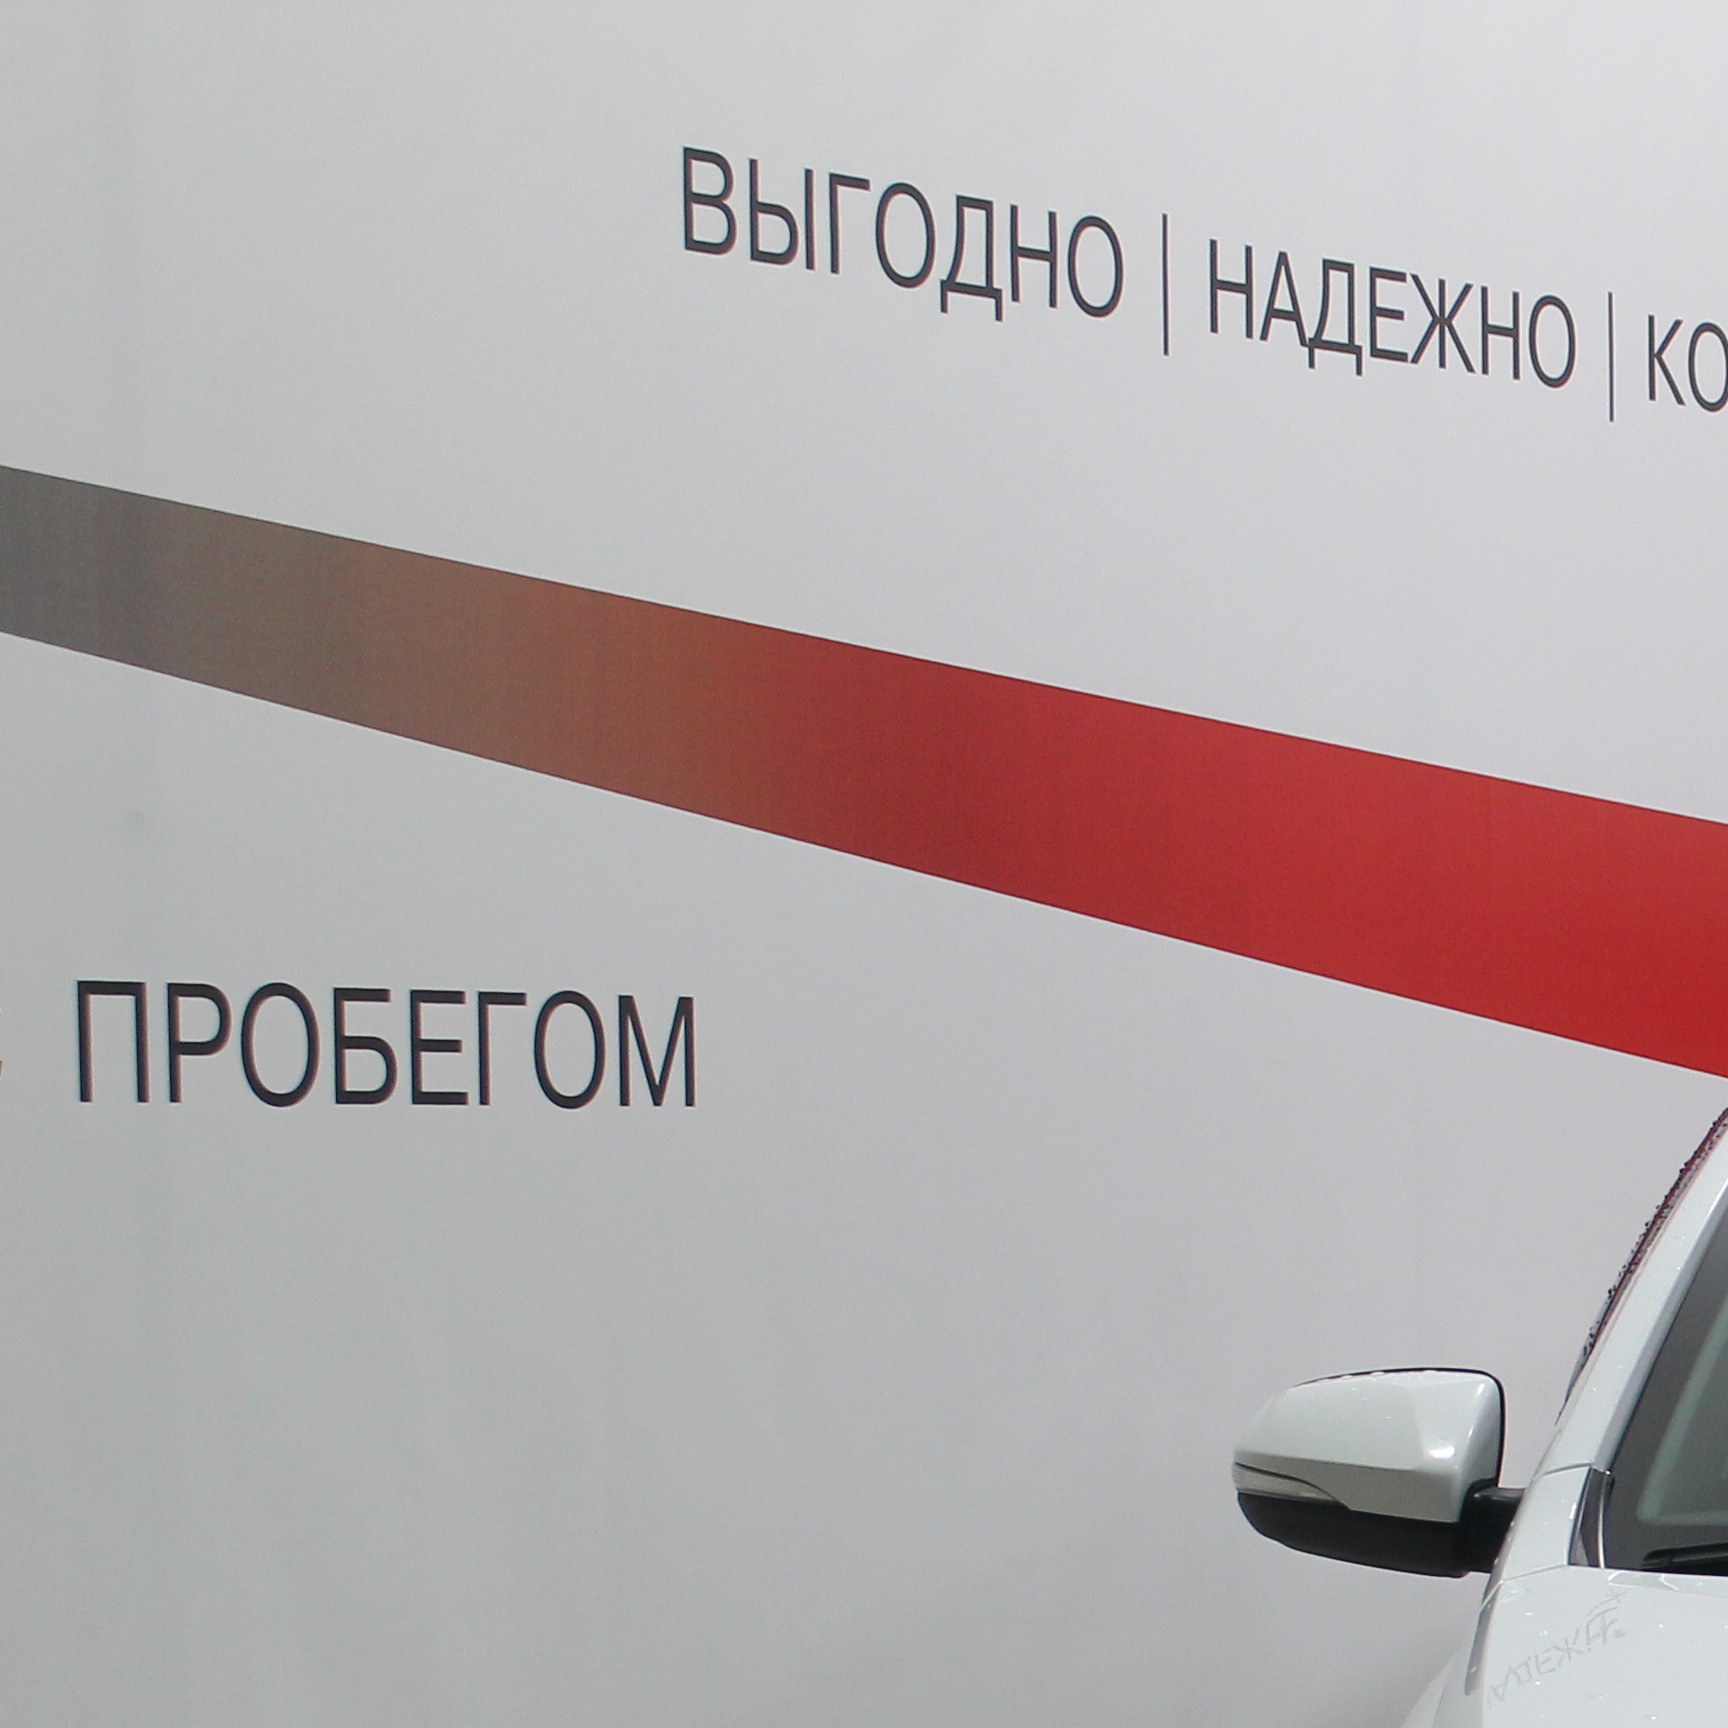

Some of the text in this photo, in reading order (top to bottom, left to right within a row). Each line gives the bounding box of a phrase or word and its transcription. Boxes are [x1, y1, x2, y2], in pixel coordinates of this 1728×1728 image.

[682, 146, 1125, 322] ВЫГОДНО
[1209, 238, 1576, 389] НАДЕЖНО
[76, 980, 696, 1110] ПРОБЕГОМ
